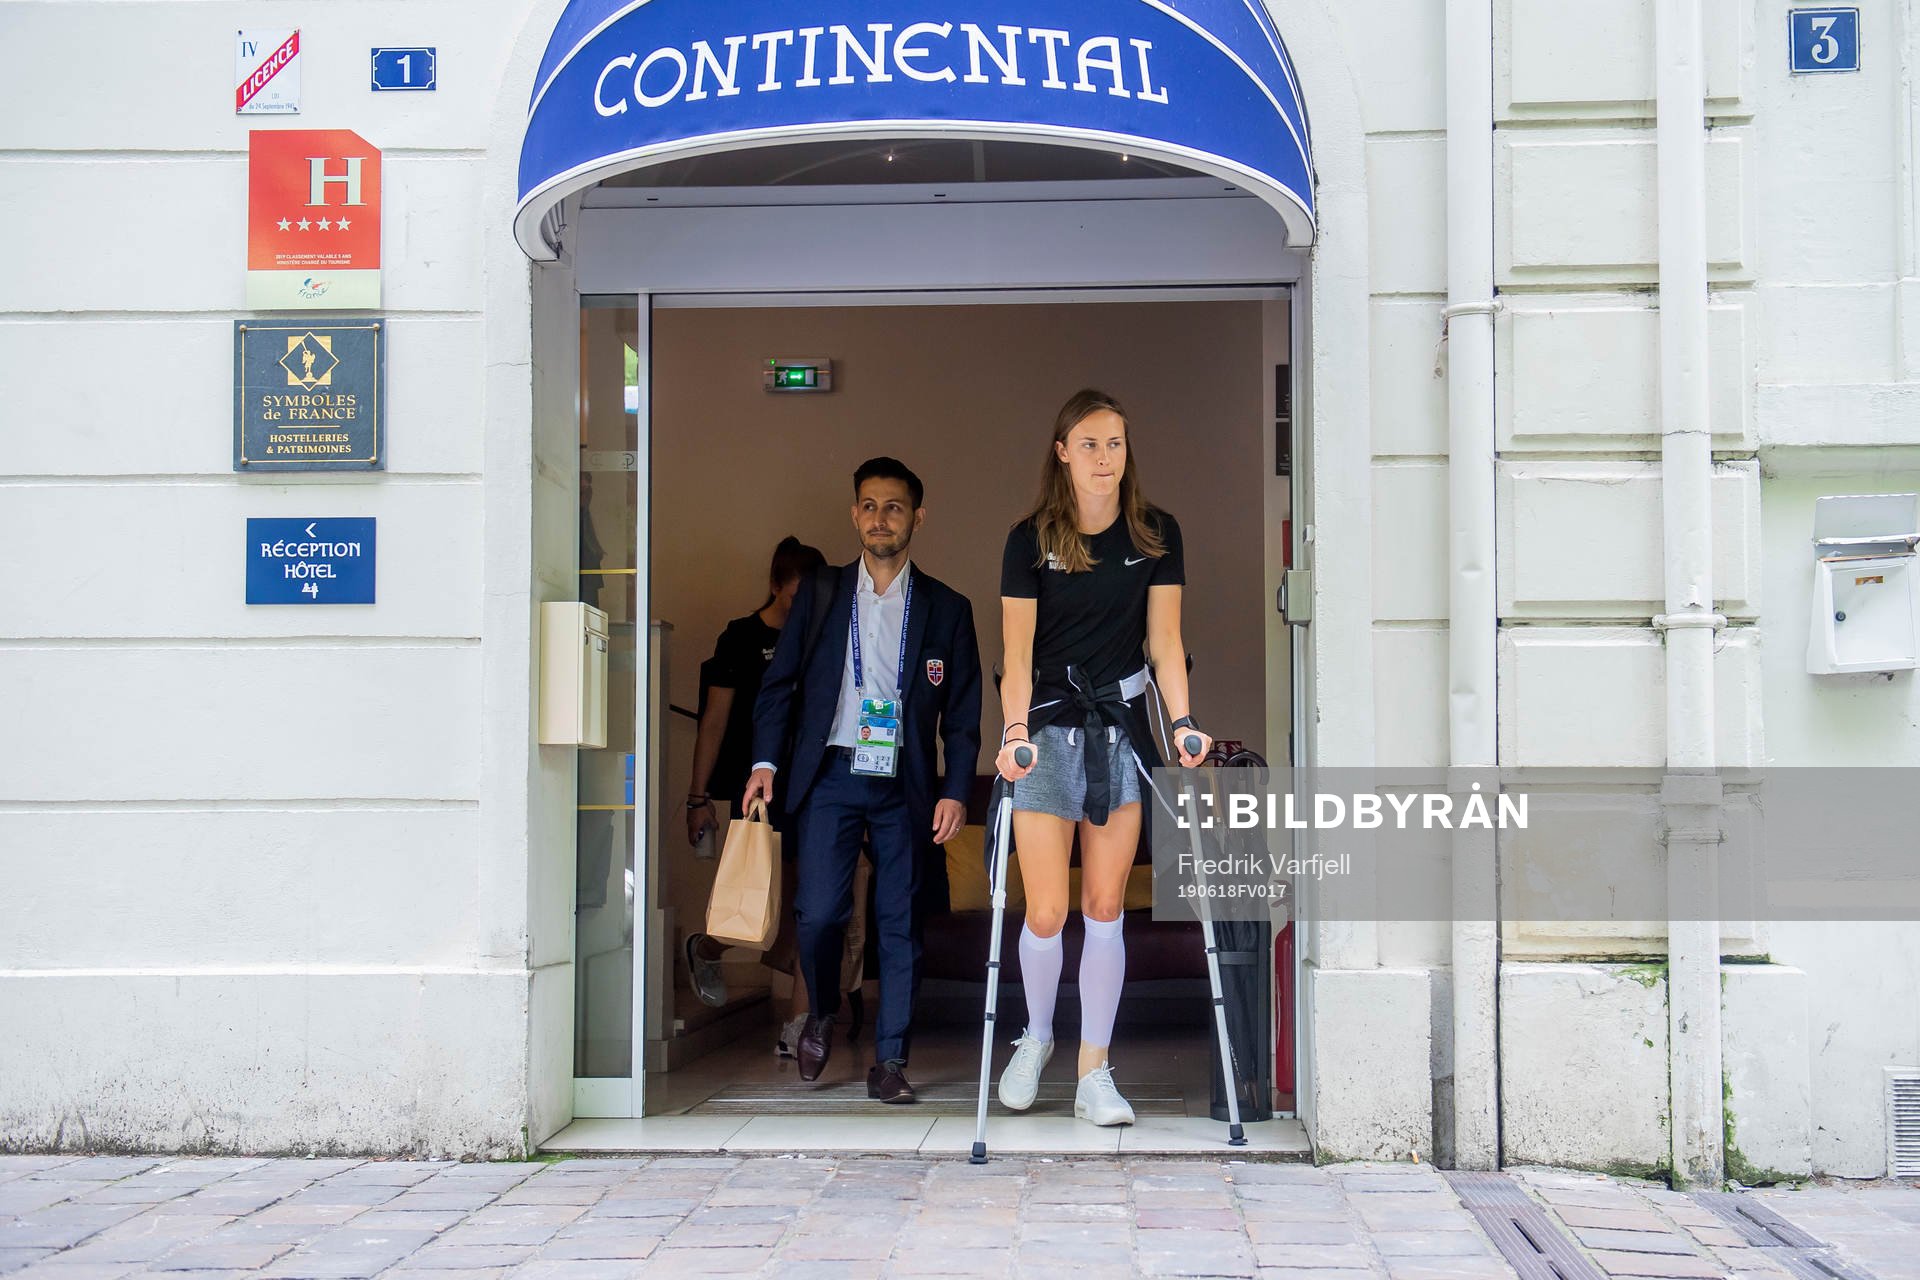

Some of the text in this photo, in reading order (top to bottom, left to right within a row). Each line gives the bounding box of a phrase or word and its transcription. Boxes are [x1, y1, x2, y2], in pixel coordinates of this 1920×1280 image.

[242, 41, 258, 57] IV
[1811, 17, 1839, 64] 3
[243, 39, 294, 102] LICENCE
[396, 54, 411, 84] 1
[593, 22, 1169, 118] CONTINENTAL
[304, 157, 368, 206] H
[262, 394, 356, 408] SYMBOLES
[263, 407, 356, 421] de FRANCE
[269, 434, 349, 443] HOSTELLERIES
[266, 444, 352, 454] & PATRIMOINES
[261, 540, 361, 558] RÉCEPTION
[284, 561, 337, 579] HÔTEL
